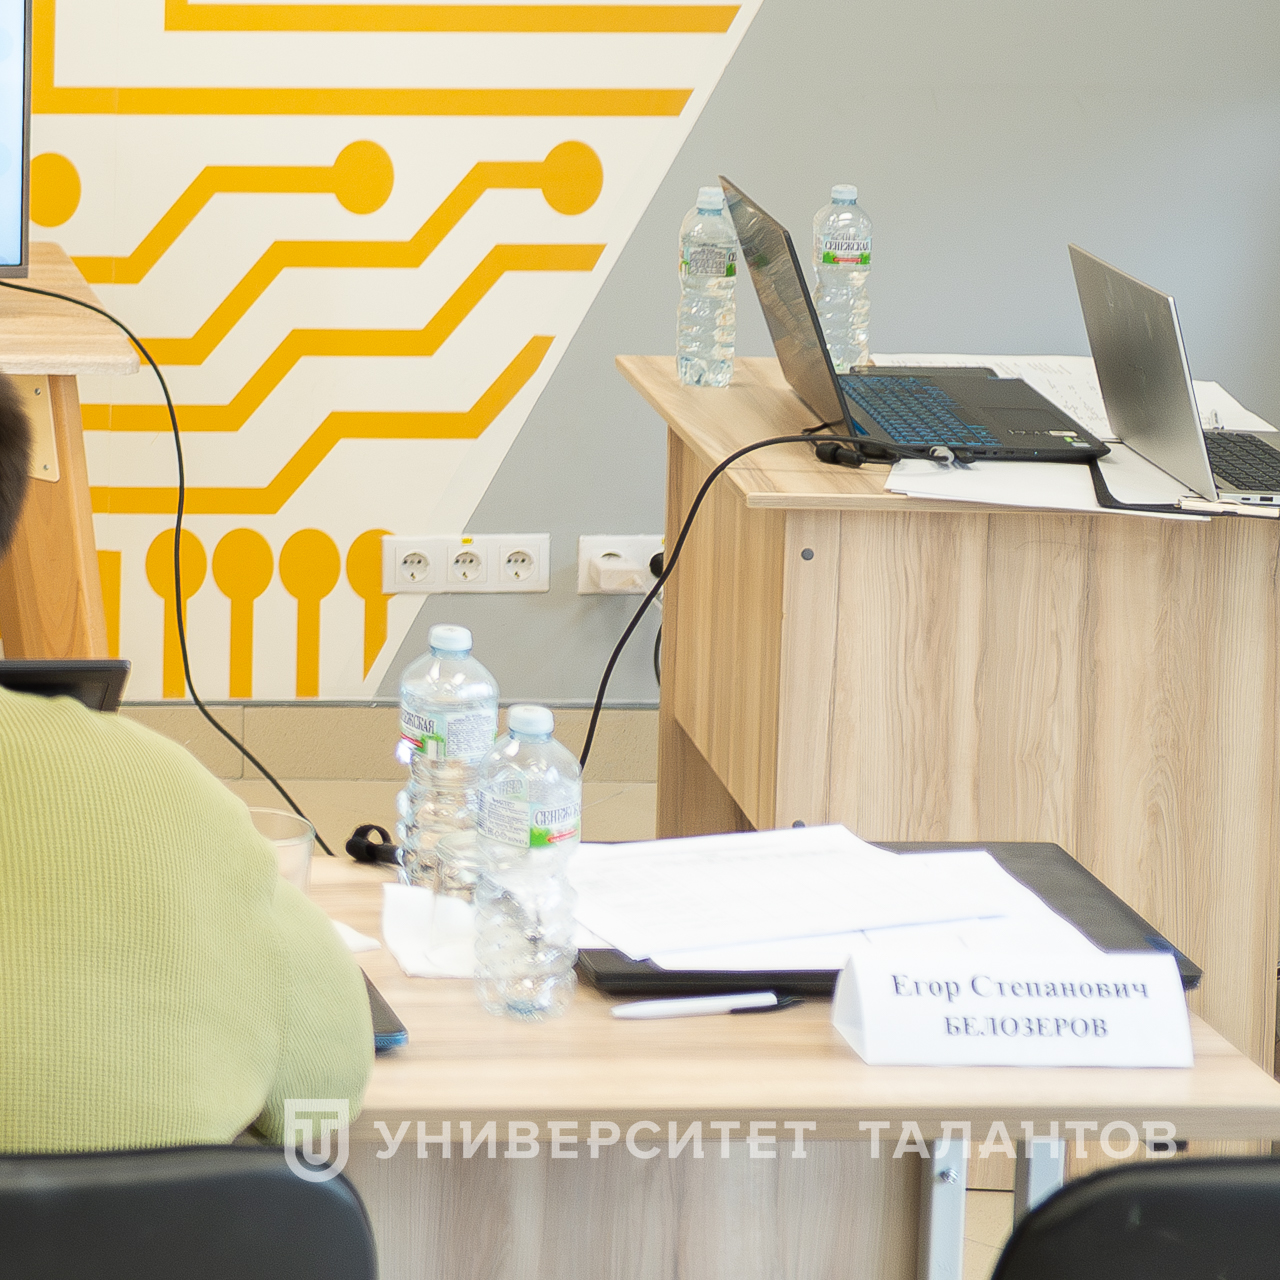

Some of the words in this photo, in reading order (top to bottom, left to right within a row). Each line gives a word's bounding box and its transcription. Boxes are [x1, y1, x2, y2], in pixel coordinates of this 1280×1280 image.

[890, 974, 960, 1003] Егор
[970, 974, 1150, 999] Степанович
[943, 1015, 1110, 1038] БЕЛОЗЕРОВ
